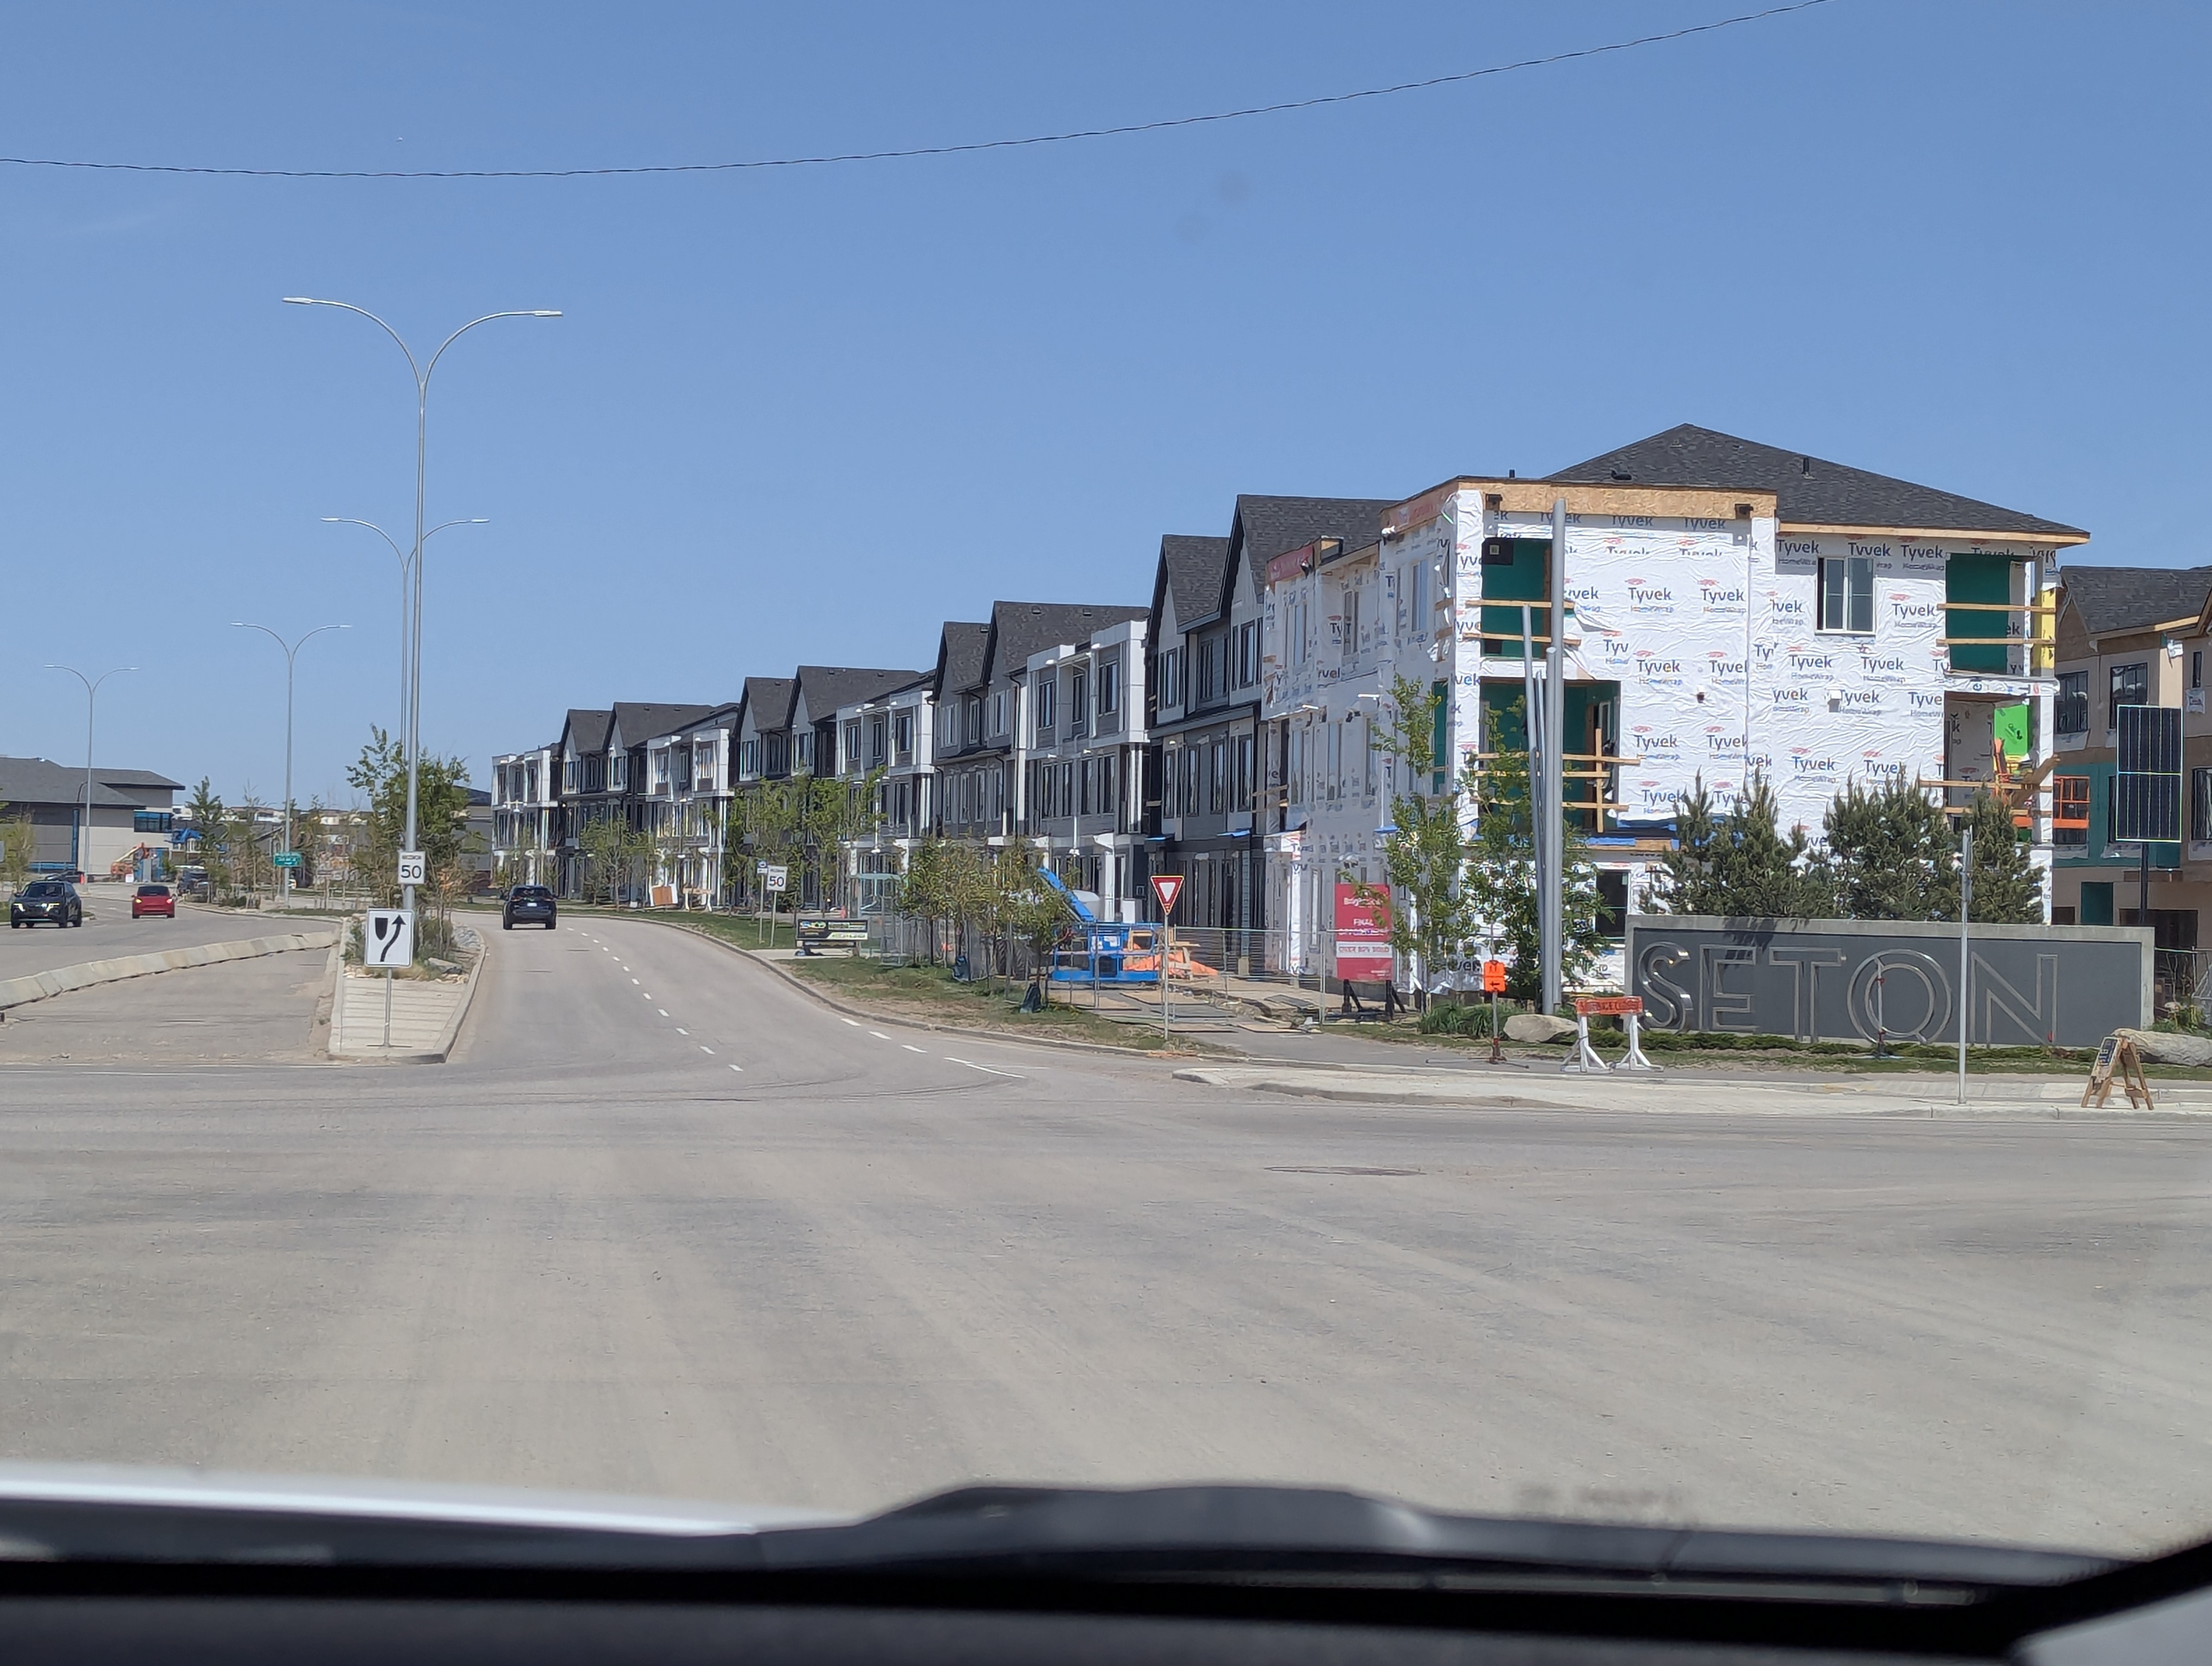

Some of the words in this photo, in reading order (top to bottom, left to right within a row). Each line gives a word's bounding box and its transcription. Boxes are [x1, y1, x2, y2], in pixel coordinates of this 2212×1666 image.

[1777, 539, 1820, 555] Tyvek
[1901, 544, 1944, 561] Tyvek
[1628, 587, 1673, 604] Tyvek
[1700, 588, 1745, 604] Tyvek
[1892, 603, 1936, 619] Tyvek
[1637, 659, 1681, 675] Tyvek
[1790, 655, 1832, 671] Tyvek
[1861, 656, 1904, 672] Tyvek
[1633, 734, 1679, 751] Tyvek
[1792, 756, 1835, 772] Tyvek
[401, 865, 422, 879] 50
[769, 876, 785, 887] 50
[1638, 941, 2059, 1047] SETON
